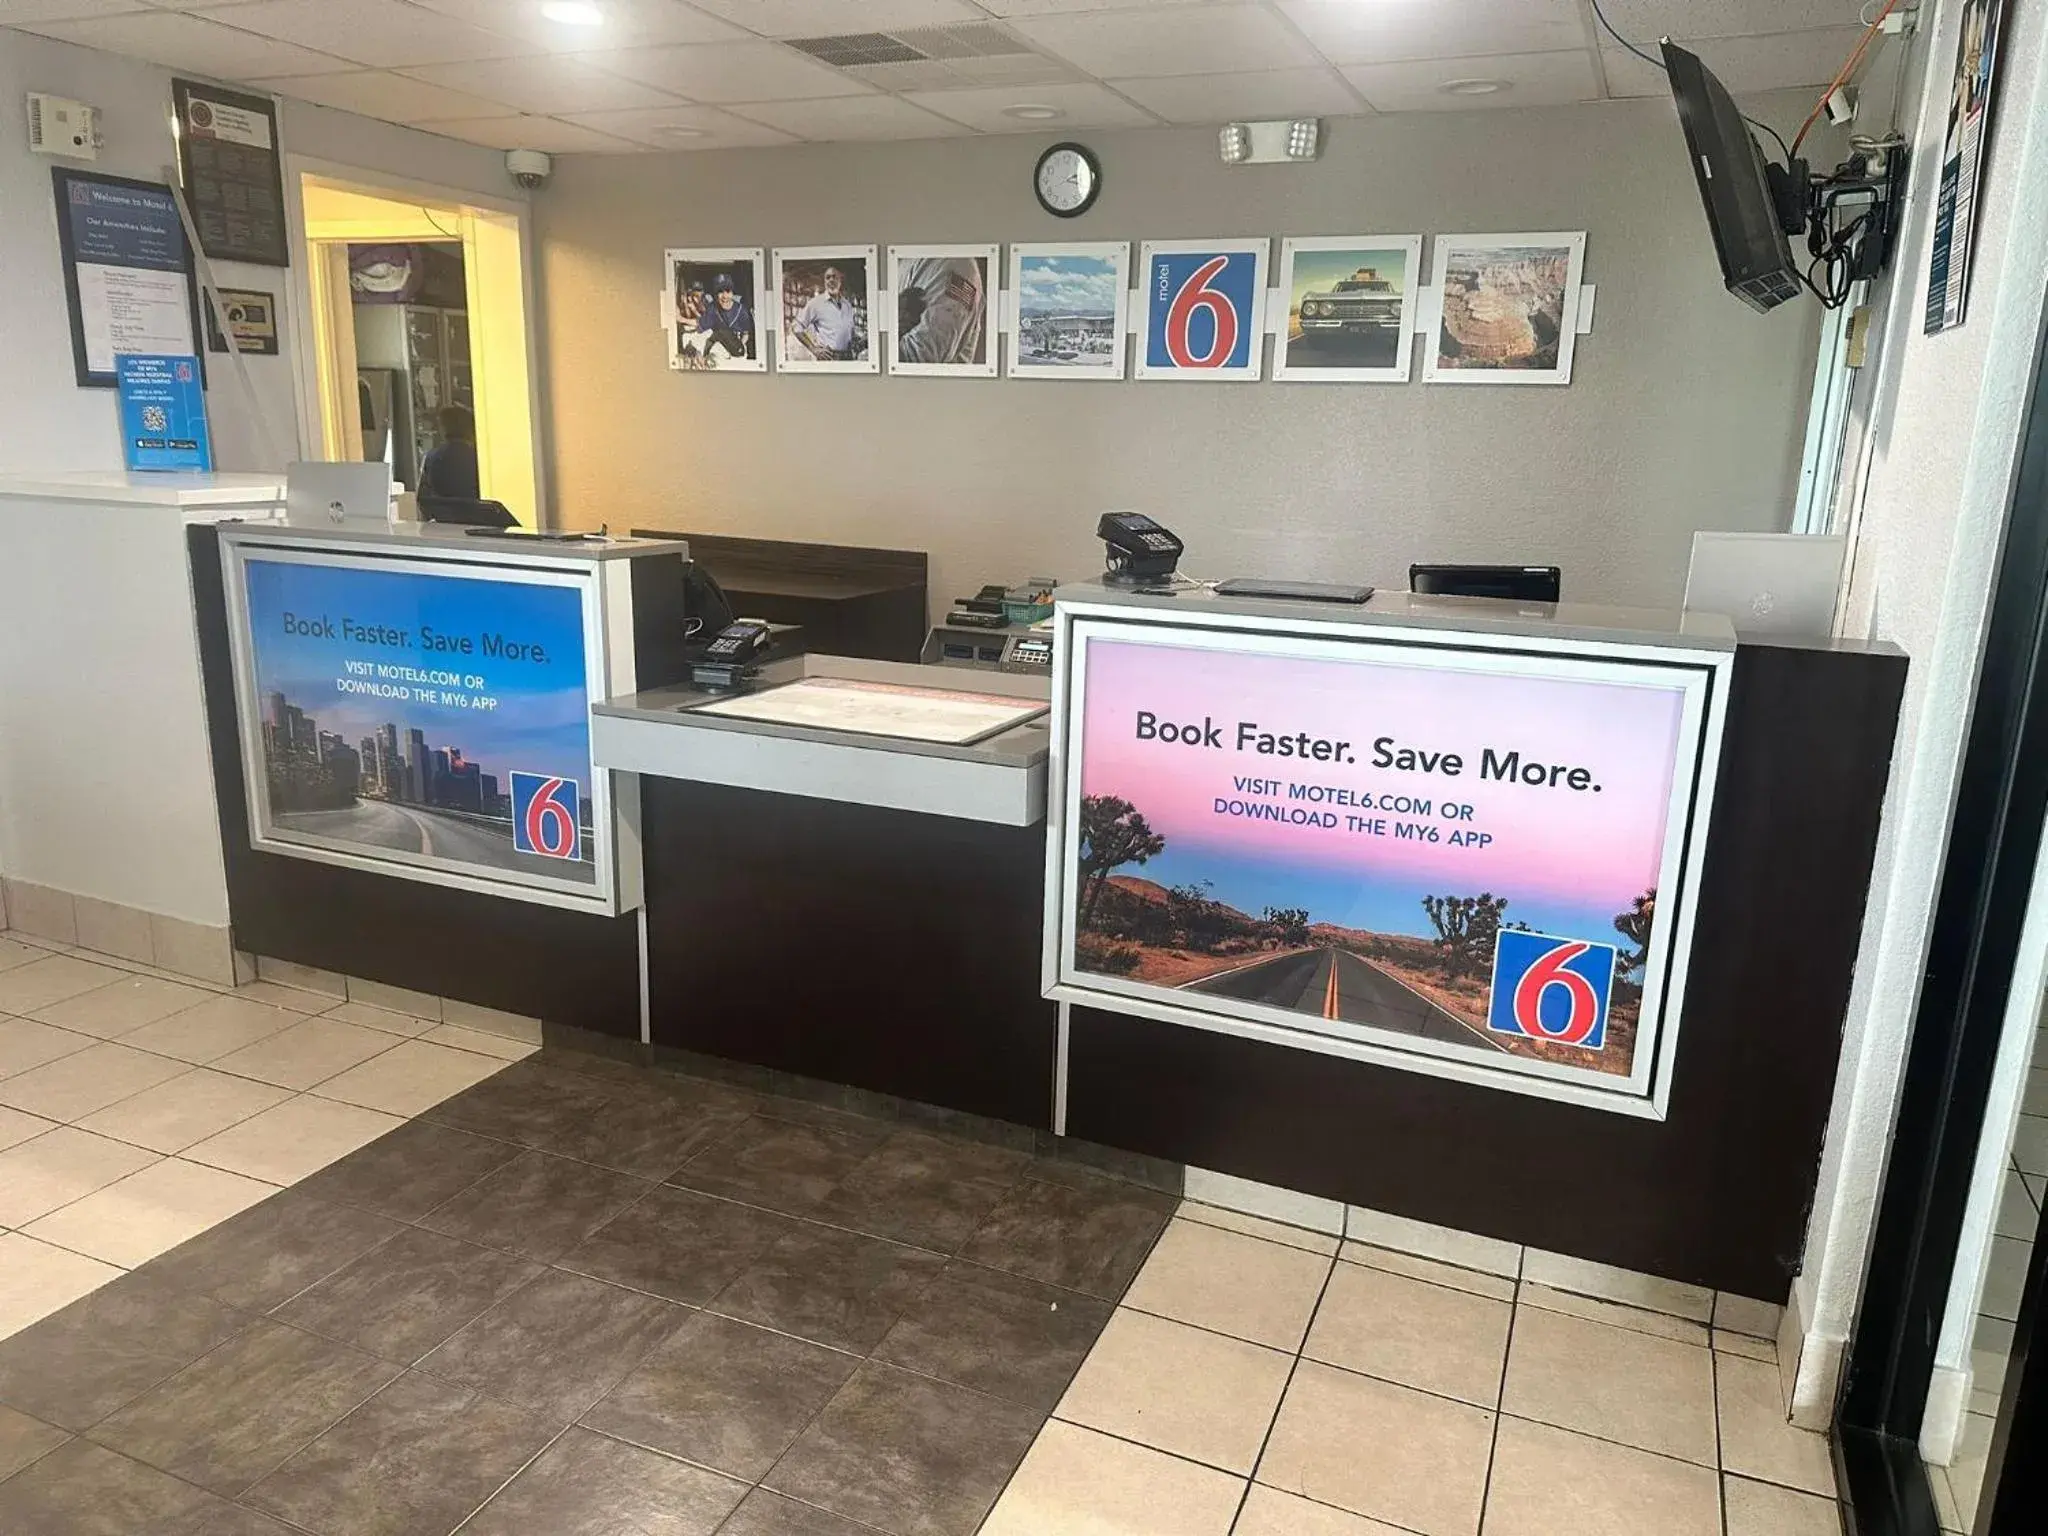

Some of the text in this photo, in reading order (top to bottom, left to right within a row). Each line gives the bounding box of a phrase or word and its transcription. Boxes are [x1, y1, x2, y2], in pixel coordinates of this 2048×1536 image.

[1159, 263, 1169, 301] motel
[1165, 255, 1238, 368] 6
[283, 612, 551, 664] Book Faster. Save More.
[336, 678, 497, 712] DOWNLOAD THE MY6 APP
[345, 660, 485, 690] VISIT MOTEL6.COM OR
[1136, 711, 1602, 792] Book Faster. Save More.
[526, 777, 575, 859] 6
[1213, 798, 1493, 849] DOWNLOAD THE MY6 APP
[1233, 775, 1474, 821] VISIT MOTEL6.COM OR
[1513, 941, 1598, 1045] 6
